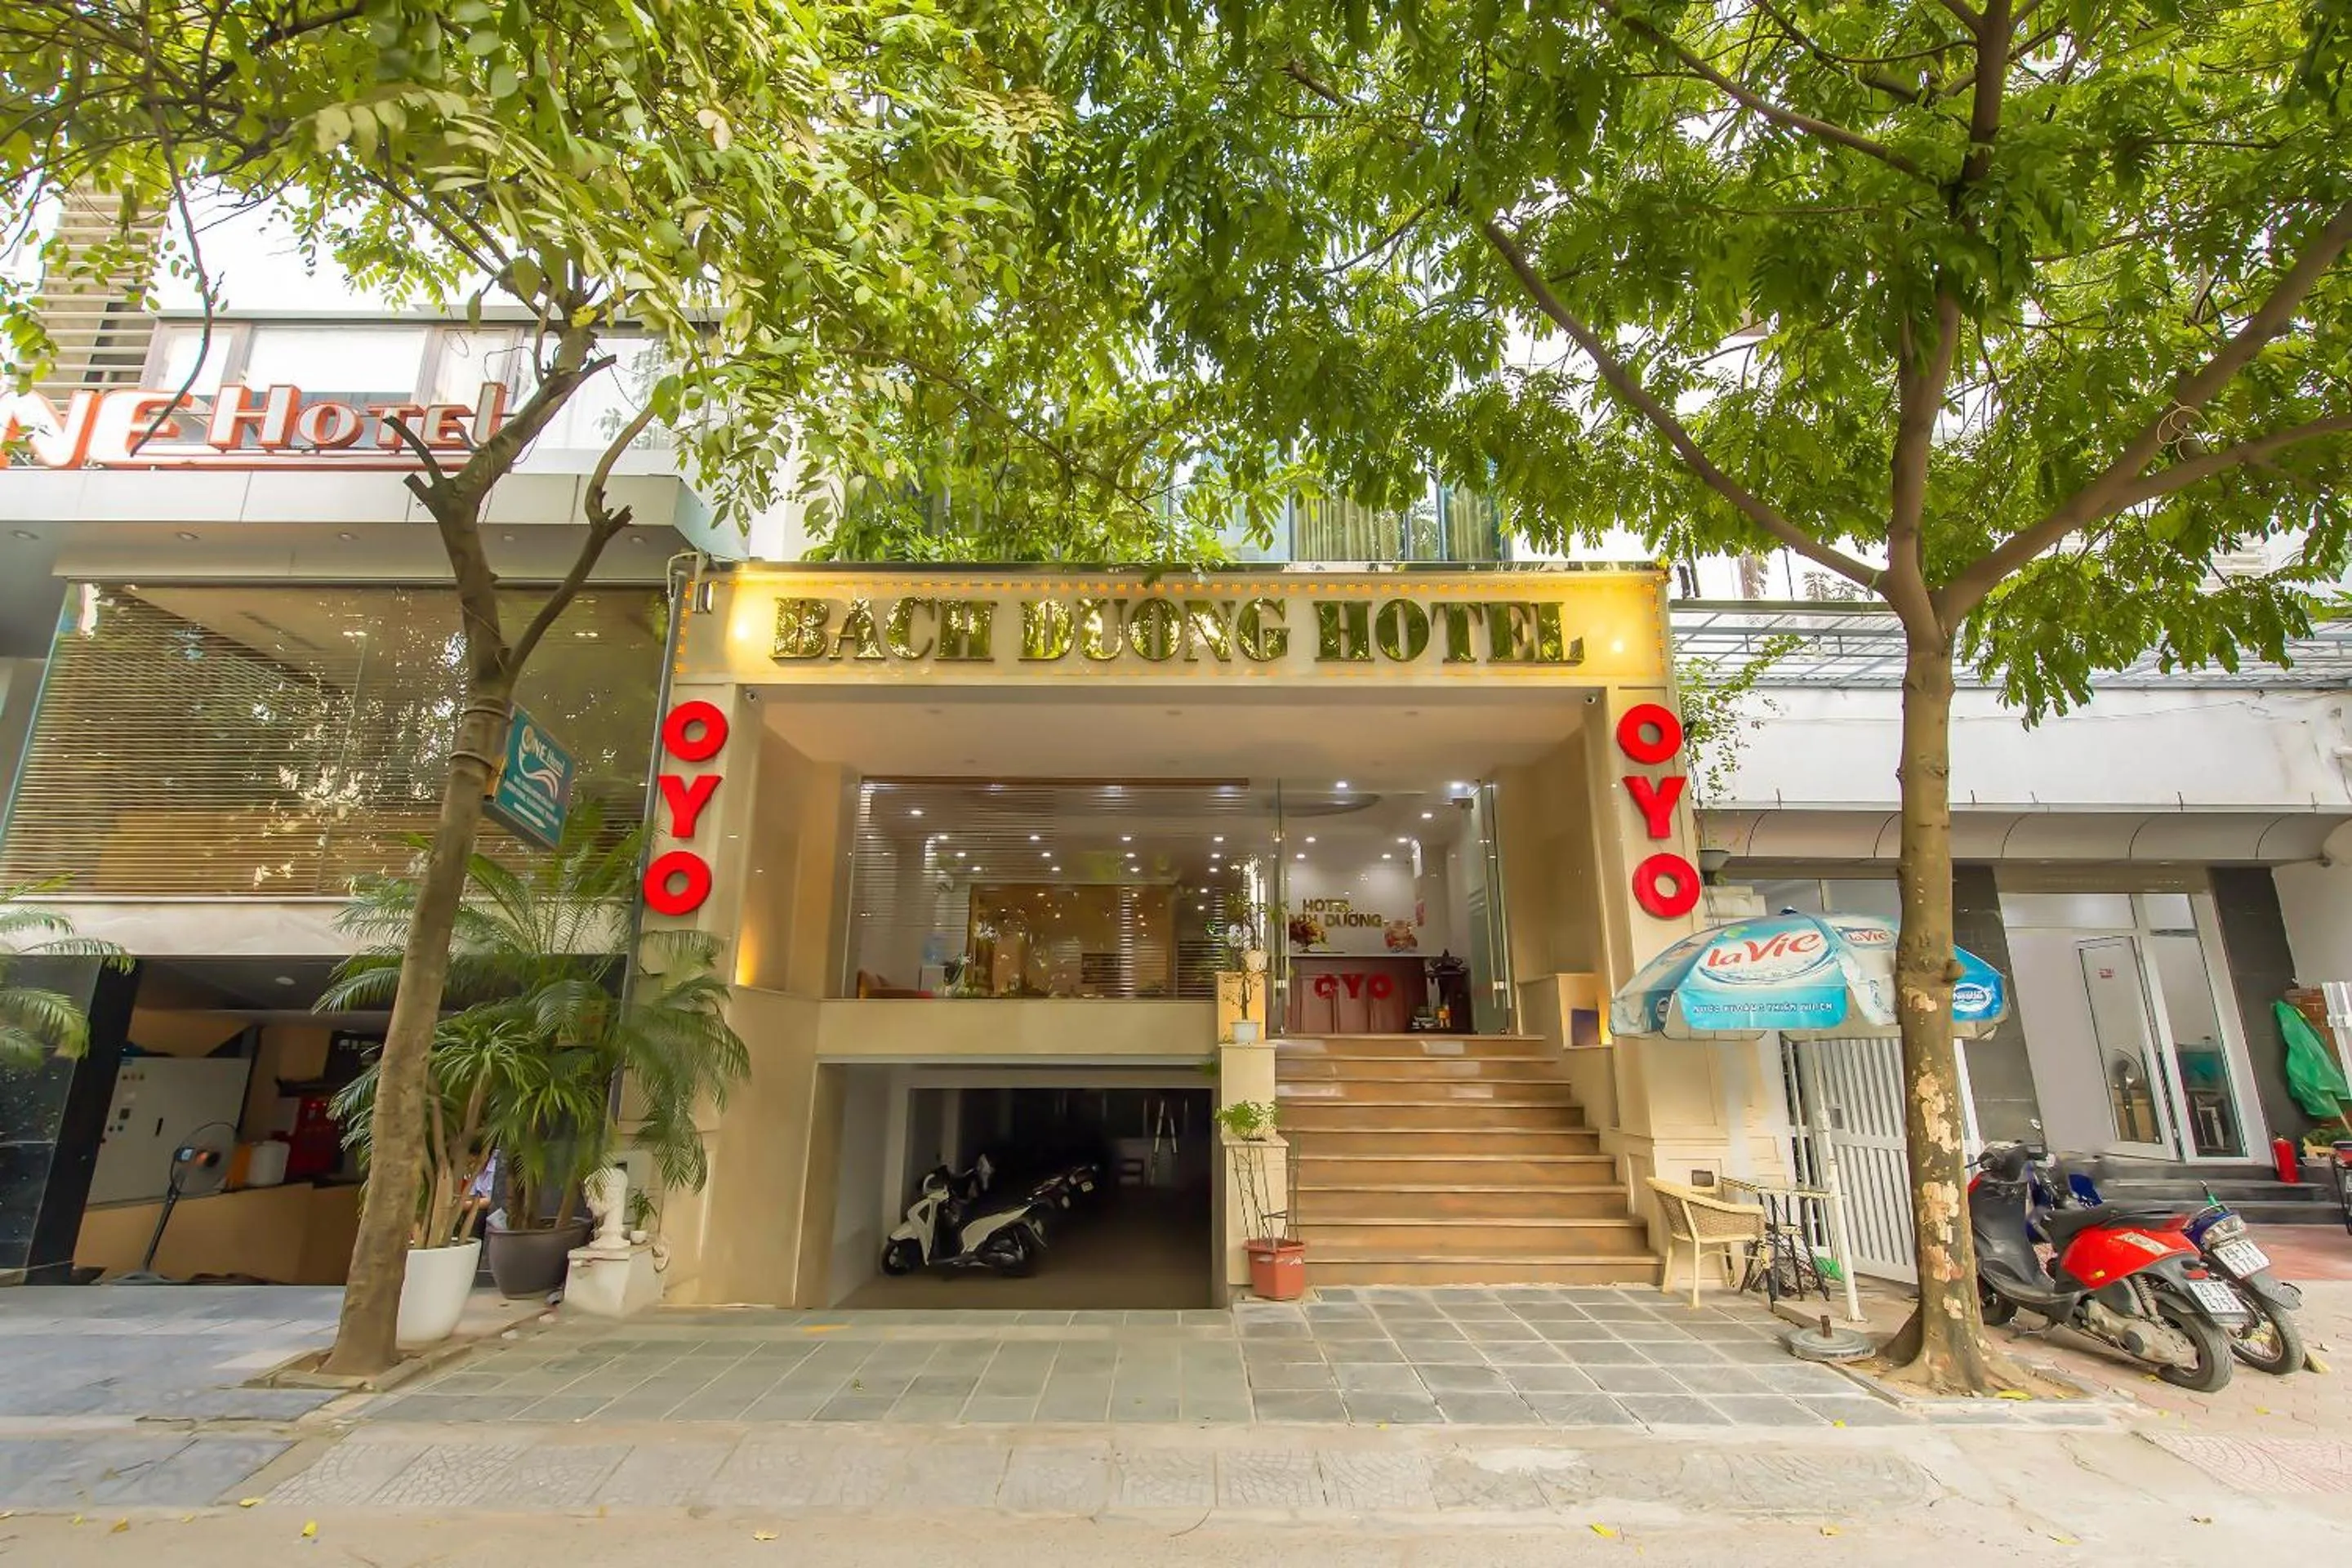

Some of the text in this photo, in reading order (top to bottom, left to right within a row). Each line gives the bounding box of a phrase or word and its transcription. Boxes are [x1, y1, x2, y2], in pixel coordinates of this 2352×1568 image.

[770, 596, 1584, 666] BACH DUONG HOTEL
[643, 701, 729, 916] OYO
[1616, 703, 1701, 920] OYO
[1303, 898, 1353, 912] HOT
